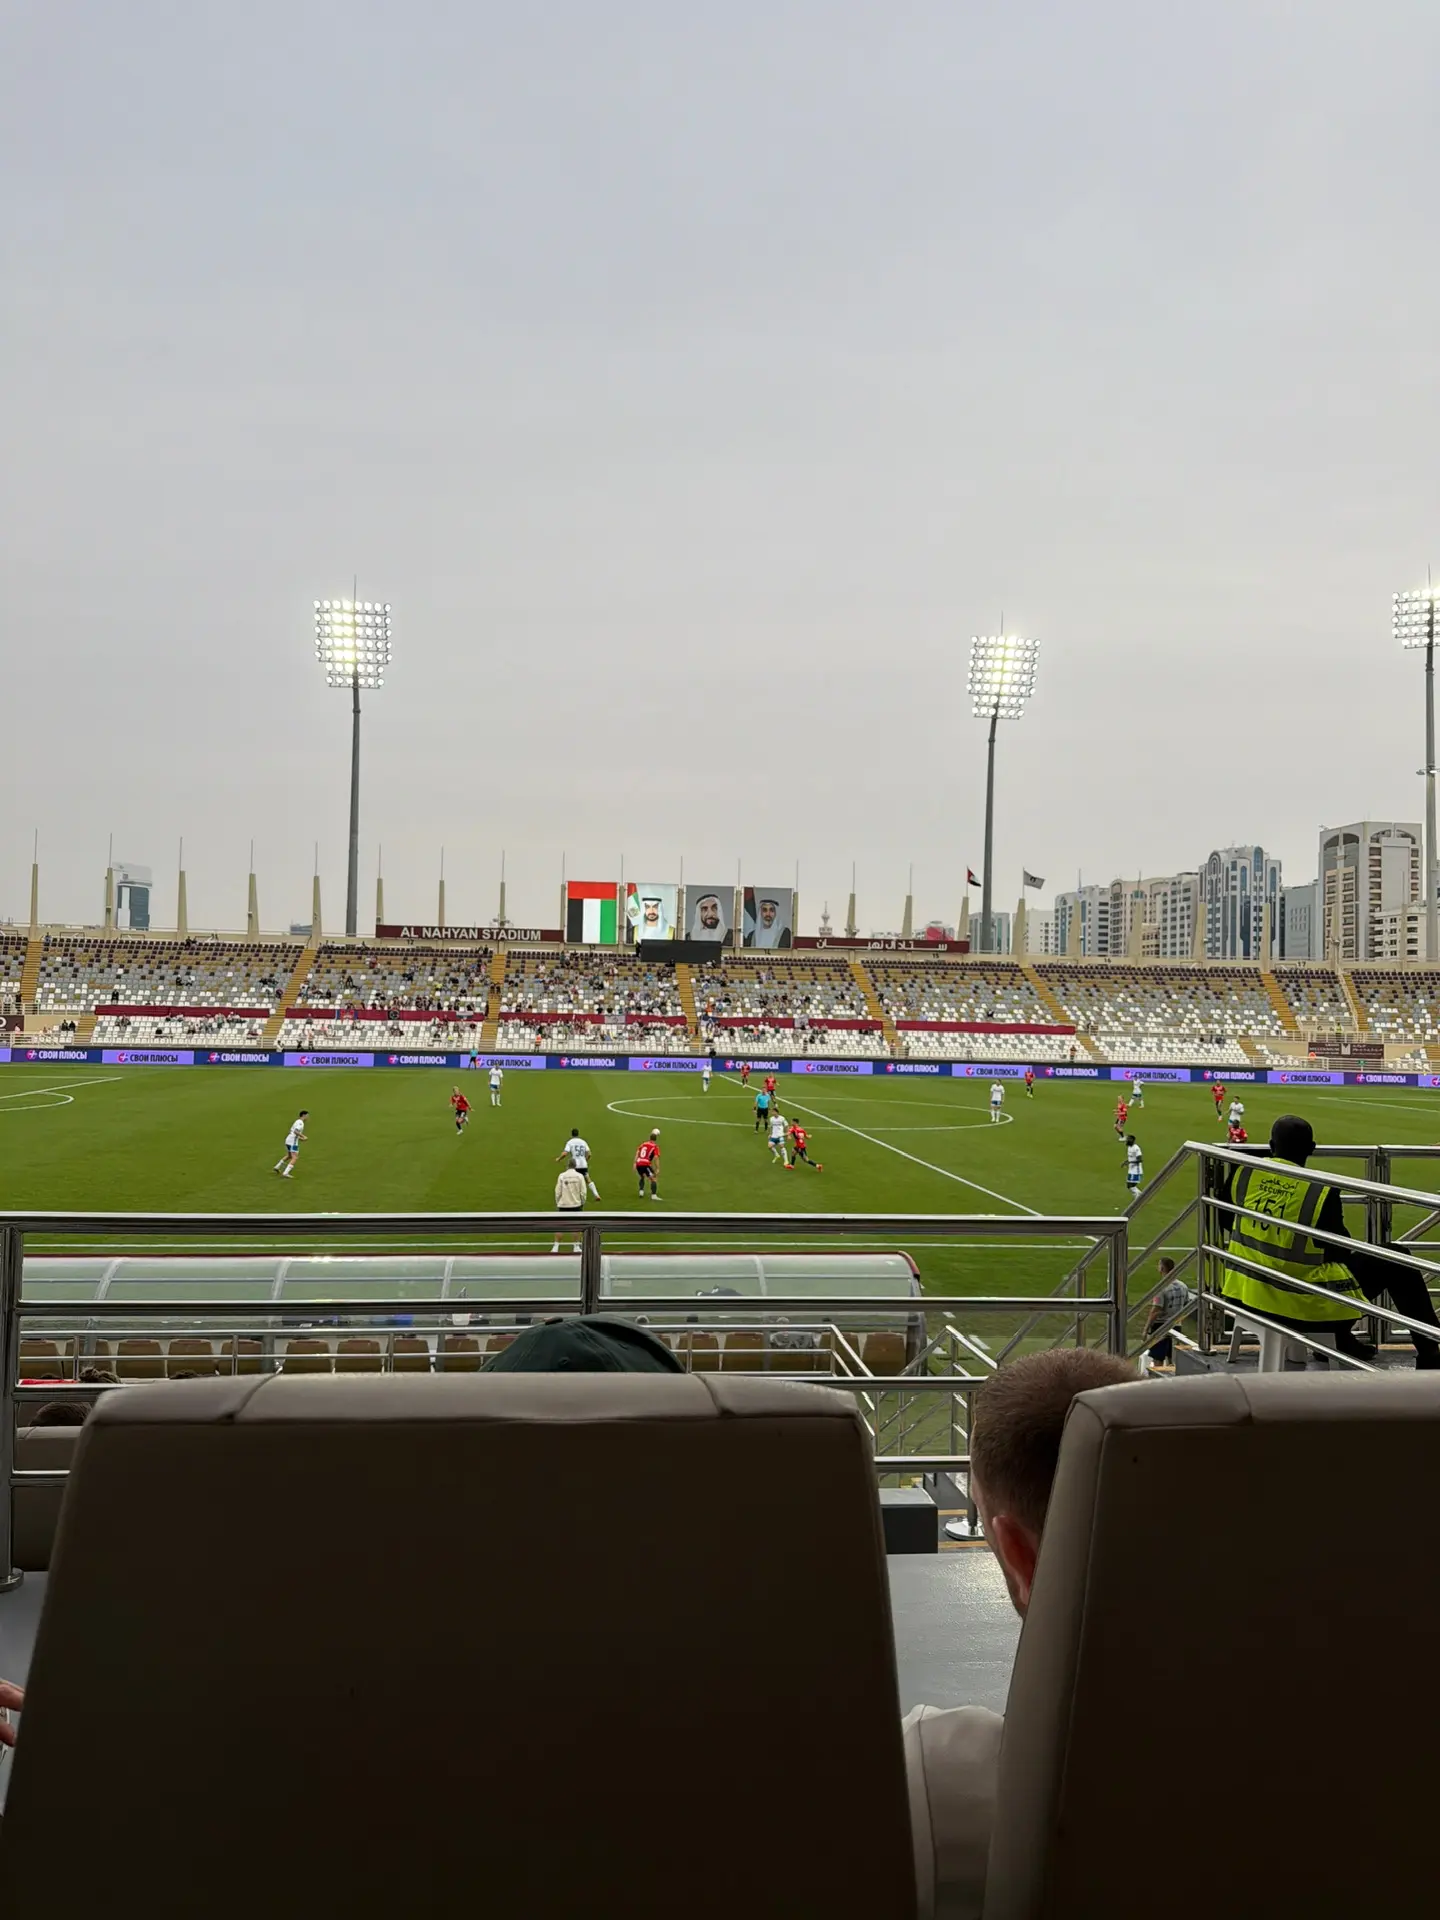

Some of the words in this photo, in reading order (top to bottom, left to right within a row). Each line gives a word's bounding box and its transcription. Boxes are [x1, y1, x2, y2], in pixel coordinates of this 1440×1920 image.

[400, 926, 418, 938] AL
[422, 927, 478, 939] NAHYAN
[482, 929, 541, 941] STADIUM
[736, 1061, 753, 1069] СВИ
[640, 1146, 648, 1158] 6
[1259, 1184, 1294, 1196] SECURITY
[1252, 1197, 1287, 1236] 151
